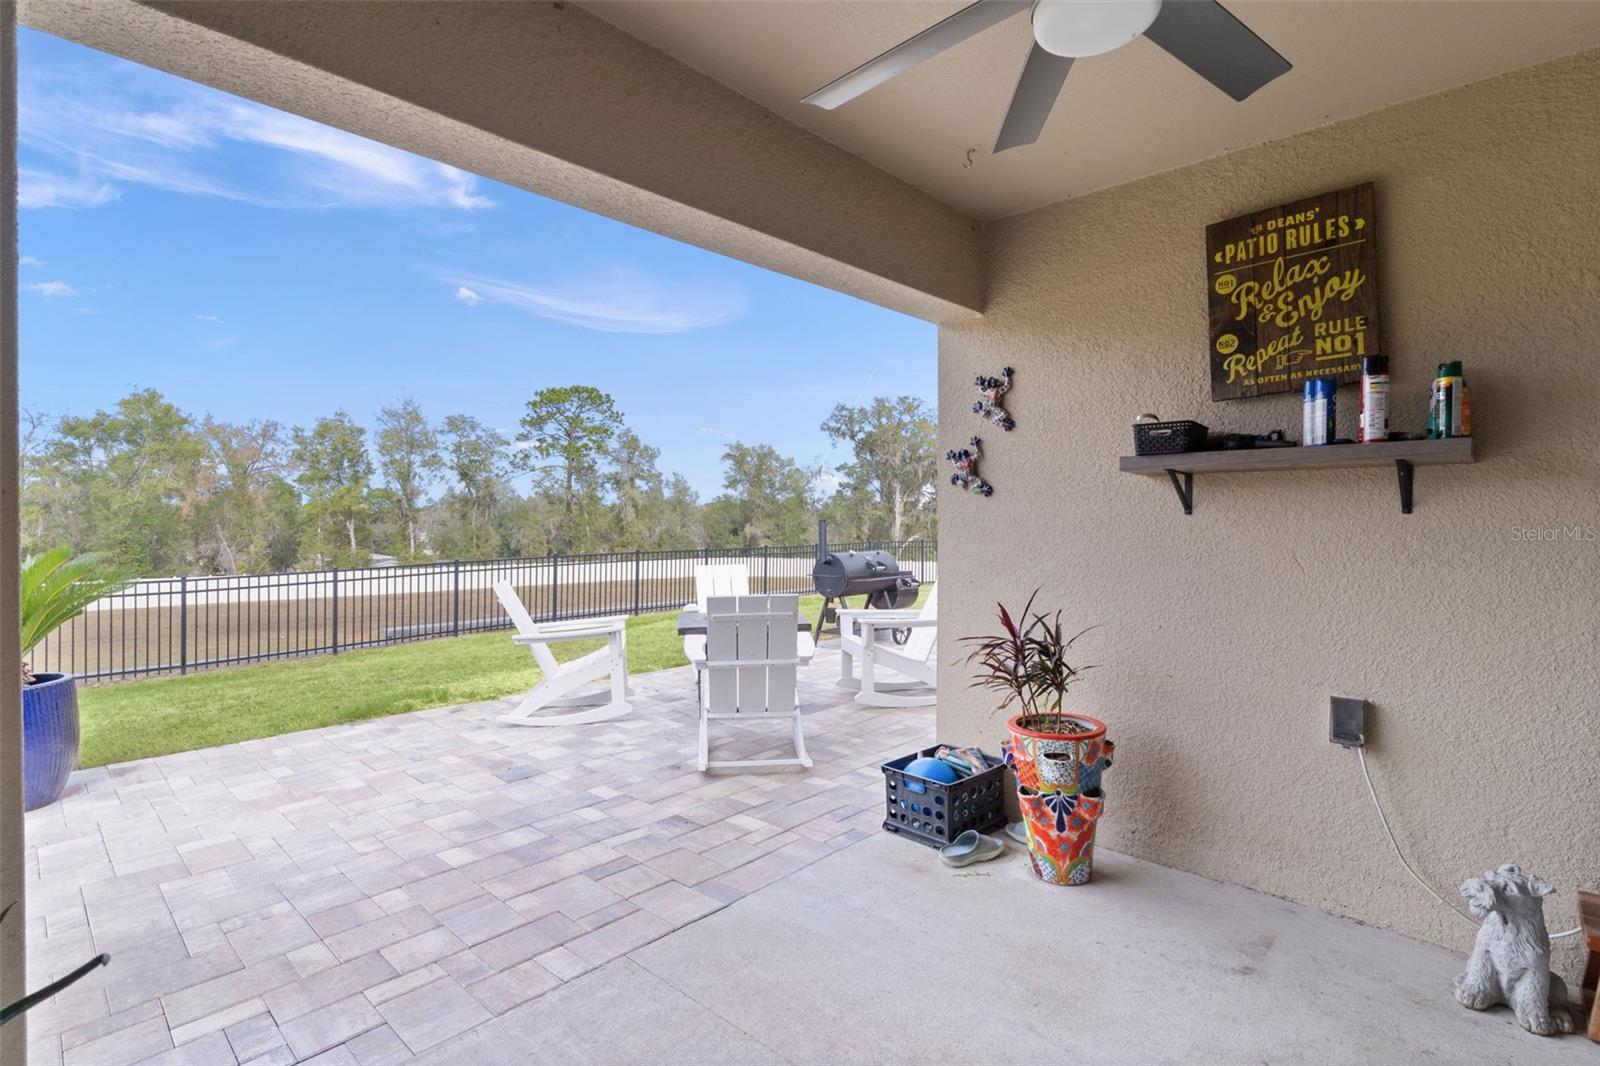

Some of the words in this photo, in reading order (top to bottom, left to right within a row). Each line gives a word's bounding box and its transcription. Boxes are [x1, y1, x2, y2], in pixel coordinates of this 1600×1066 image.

[1225, 232, 1278, 264] PATIO
[1286, 215, 1350, 250] RULES
[1231, 256, 1331, 321] Relax
[1258, 303, 1276, 323] &
[1275, 268, 1366, 328] Enjoy
[1314, 315, 1368, 337] RULE
[1315, 331, 1366, 356] NO1
[1223, 325, 1304, 384] Repeat
[1243, 378, 1255, 386] AS
[1257, 374, 1288, 384] OFTEN
[1290, 371, 1303, 380] AS
[1306, 363, 1362, 377] NECESSARY
